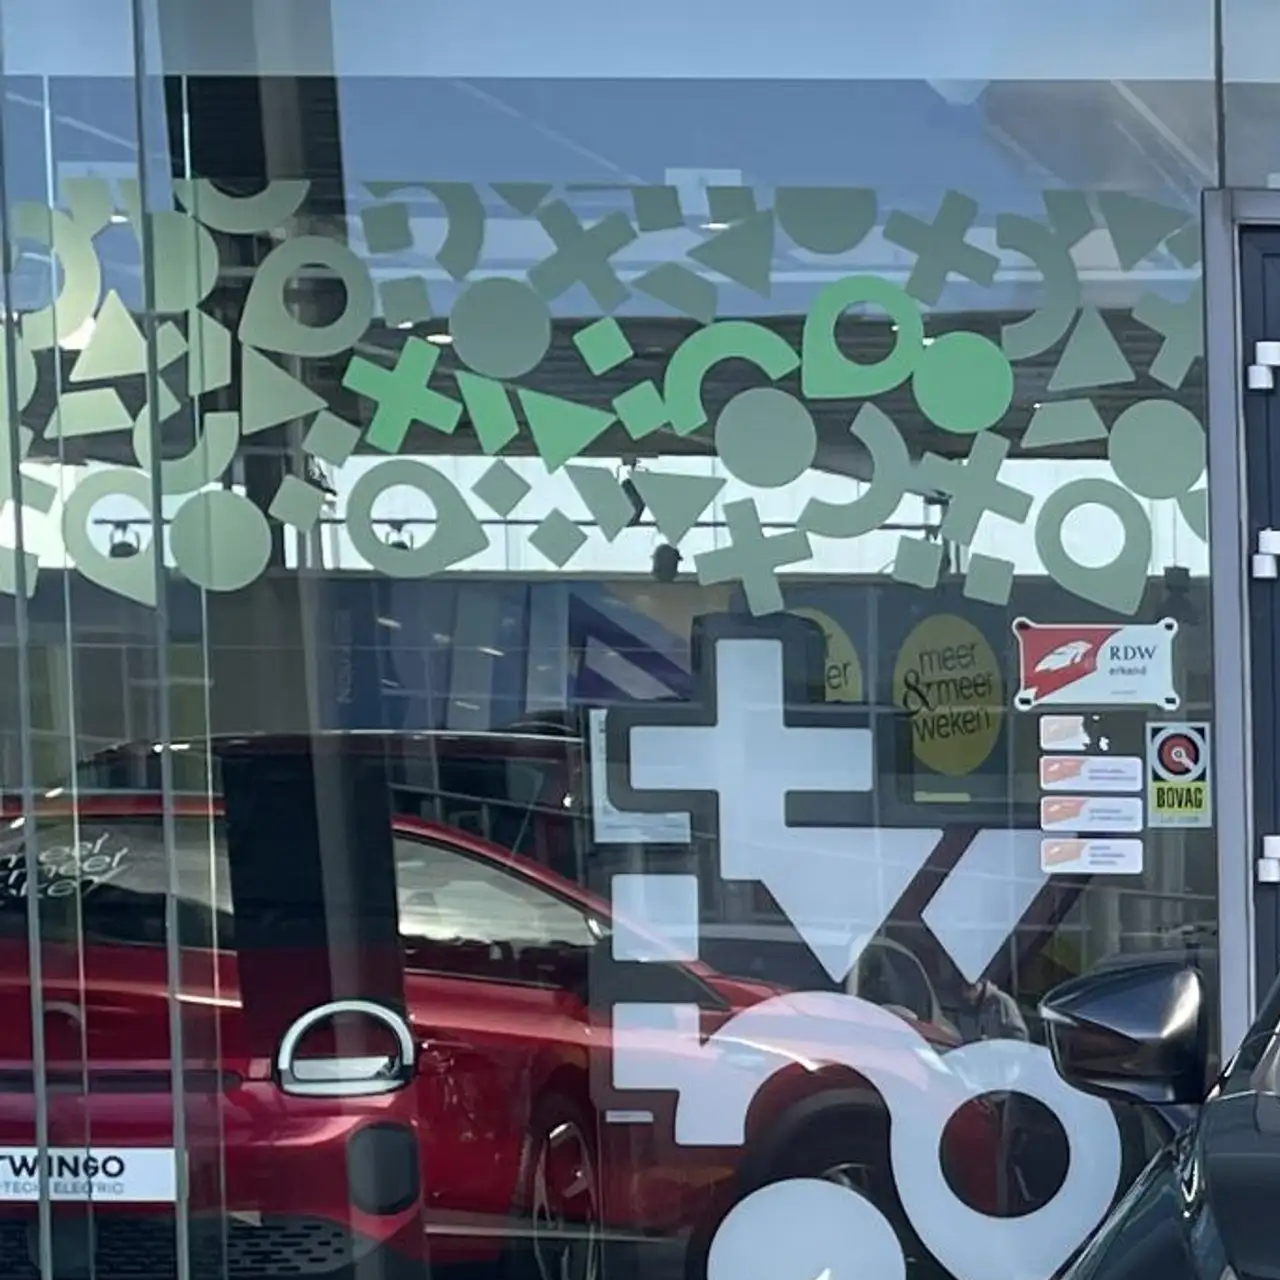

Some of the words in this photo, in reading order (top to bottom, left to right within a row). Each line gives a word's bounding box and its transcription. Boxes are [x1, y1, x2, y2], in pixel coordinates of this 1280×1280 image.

[918, 642, 977, 674] meer
[1110, 645, 1157, 660] RDW
[927, 671, 993, 701] meer
[913, 709, 991, 742] weken
[1156, 787, 1203, 809] BOVAG
